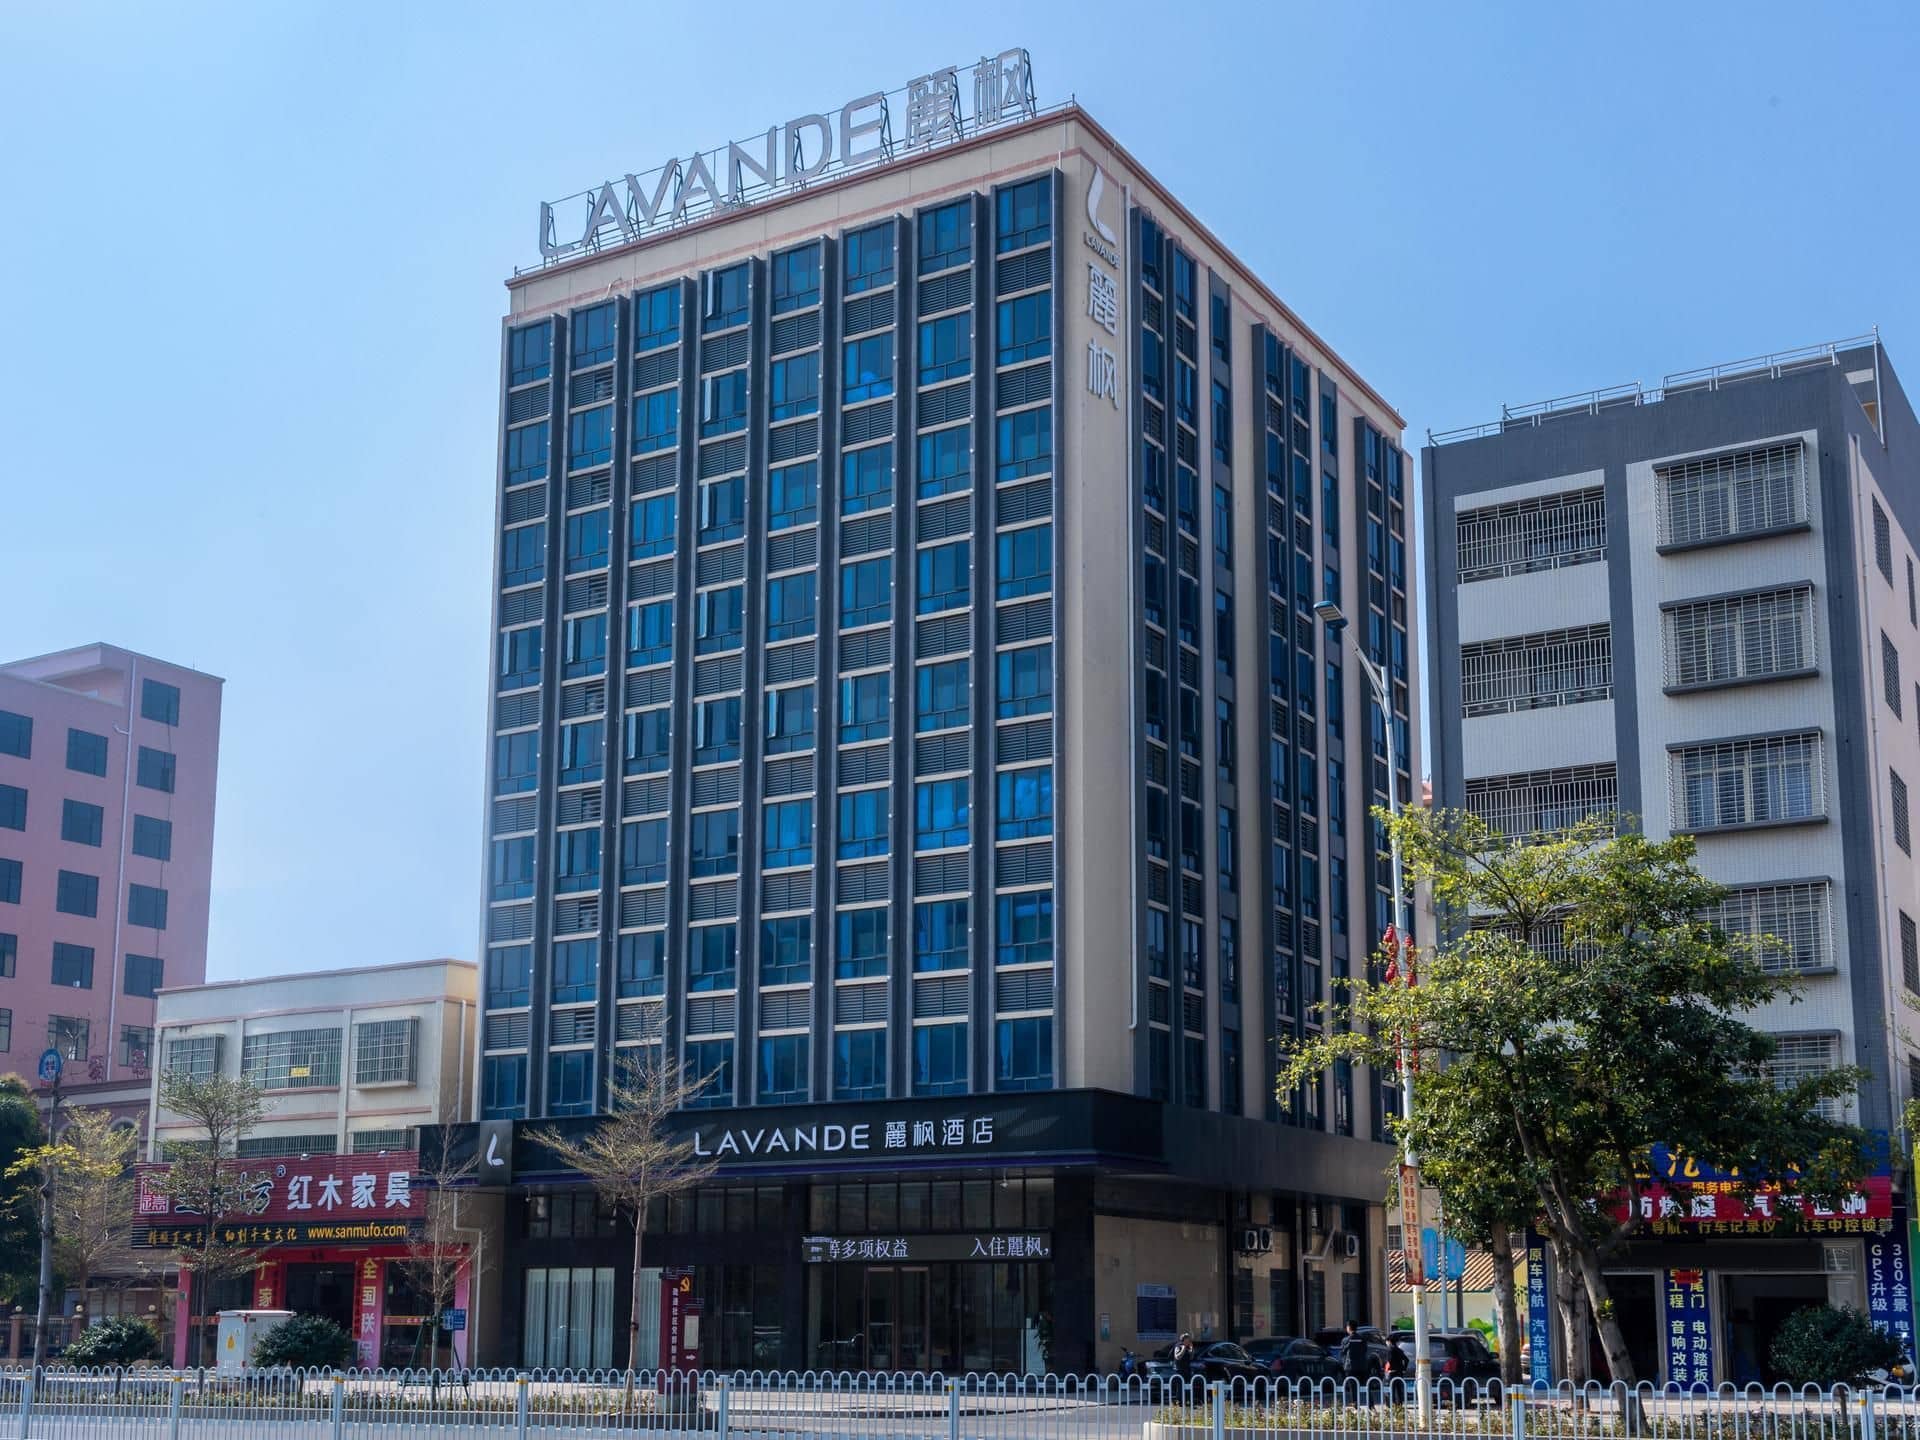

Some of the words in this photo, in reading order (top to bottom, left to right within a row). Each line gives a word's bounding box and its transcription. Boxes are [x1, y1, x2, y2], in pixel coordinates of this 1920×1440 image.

[540, 91, 885, 258] LAVANDE
[1083, 232, 1121, 270] LAVANDE
[694, 1123, 870, 1156] LAVANDE
[287, 1171, 411, 1211] 红木家具
[307, 1221, 408, 1239] www.sanmufo.com
[360, 1257, 379, 1361] 全国联保
[1528, 1247, 1545, 1309] 原车导航
[1891, 1243, 1909, 1313] 360全景
[1531, 1319, 1549, 1380] 汽车贴膜
[1671, 1319, 1688, 1382] 音响改装
[1692, 1319, 1709, 1383] 电动踏板
